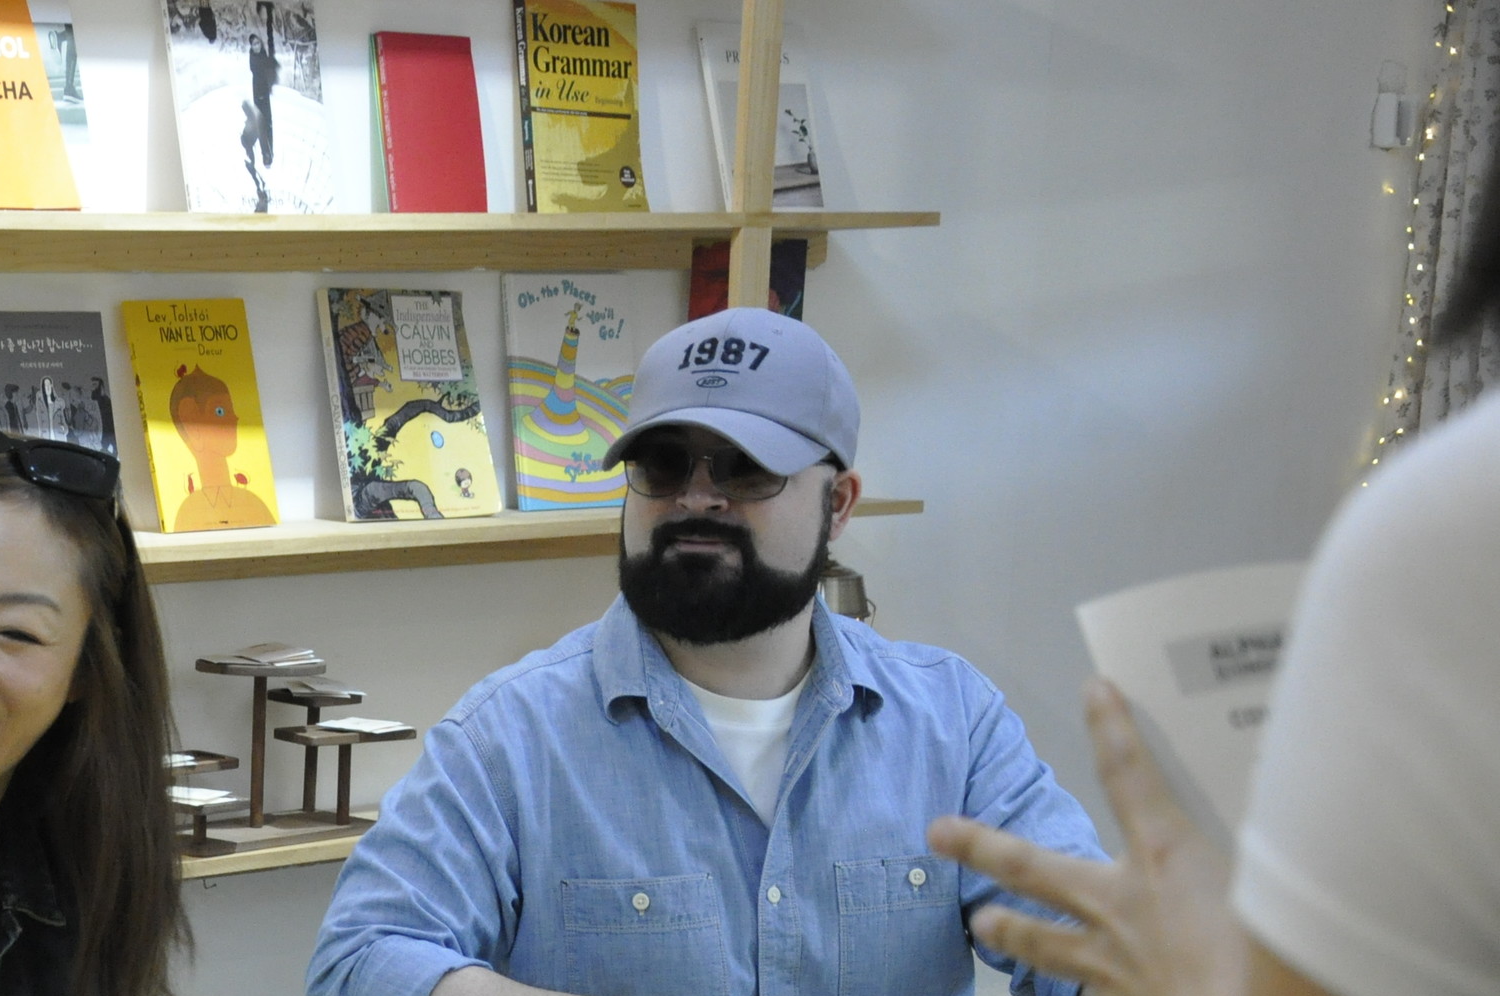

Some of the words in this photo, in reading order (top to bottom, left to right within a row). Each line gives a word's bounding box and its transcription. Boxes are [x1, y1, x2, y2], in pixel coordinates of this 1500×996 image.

[531, 12, 610, 48] Korean
[517, 41, 526, 87] Grammar
[533, 45, 632, 80] Grammar
[535, 80, 551, 100] in
[556, 78, 590, 103] Use
[517, 292, 539, 309] Oh,
[540, 284, 560, 298] the
[561, 279, 597, 306] Places
[146, 306, 167, 323] Lev
[170, 304, 210, 323] Tolstói
[586, 307, 614, 325] You'll
[159, 322, 182, 343] IVÁN
[185, 326, 196, 343] EL
[198, 324, 238, 342] TONTO
[400, 323, 451, 341] CALVIN
[598, 318, 625, 340] Go!
[6, 338, 16, 353] 좀
[16, 338, 45, 353] 별나긴
[197, 344, 223, 356] Decur
[419, 341, 434, 349] AND
[678, 337, 770, 371] 1987
[402, 348, 457, 366] HOBBES
[331, 394, 342, 433] CALVIN
[338, 444, 350, 489] HOBBES
